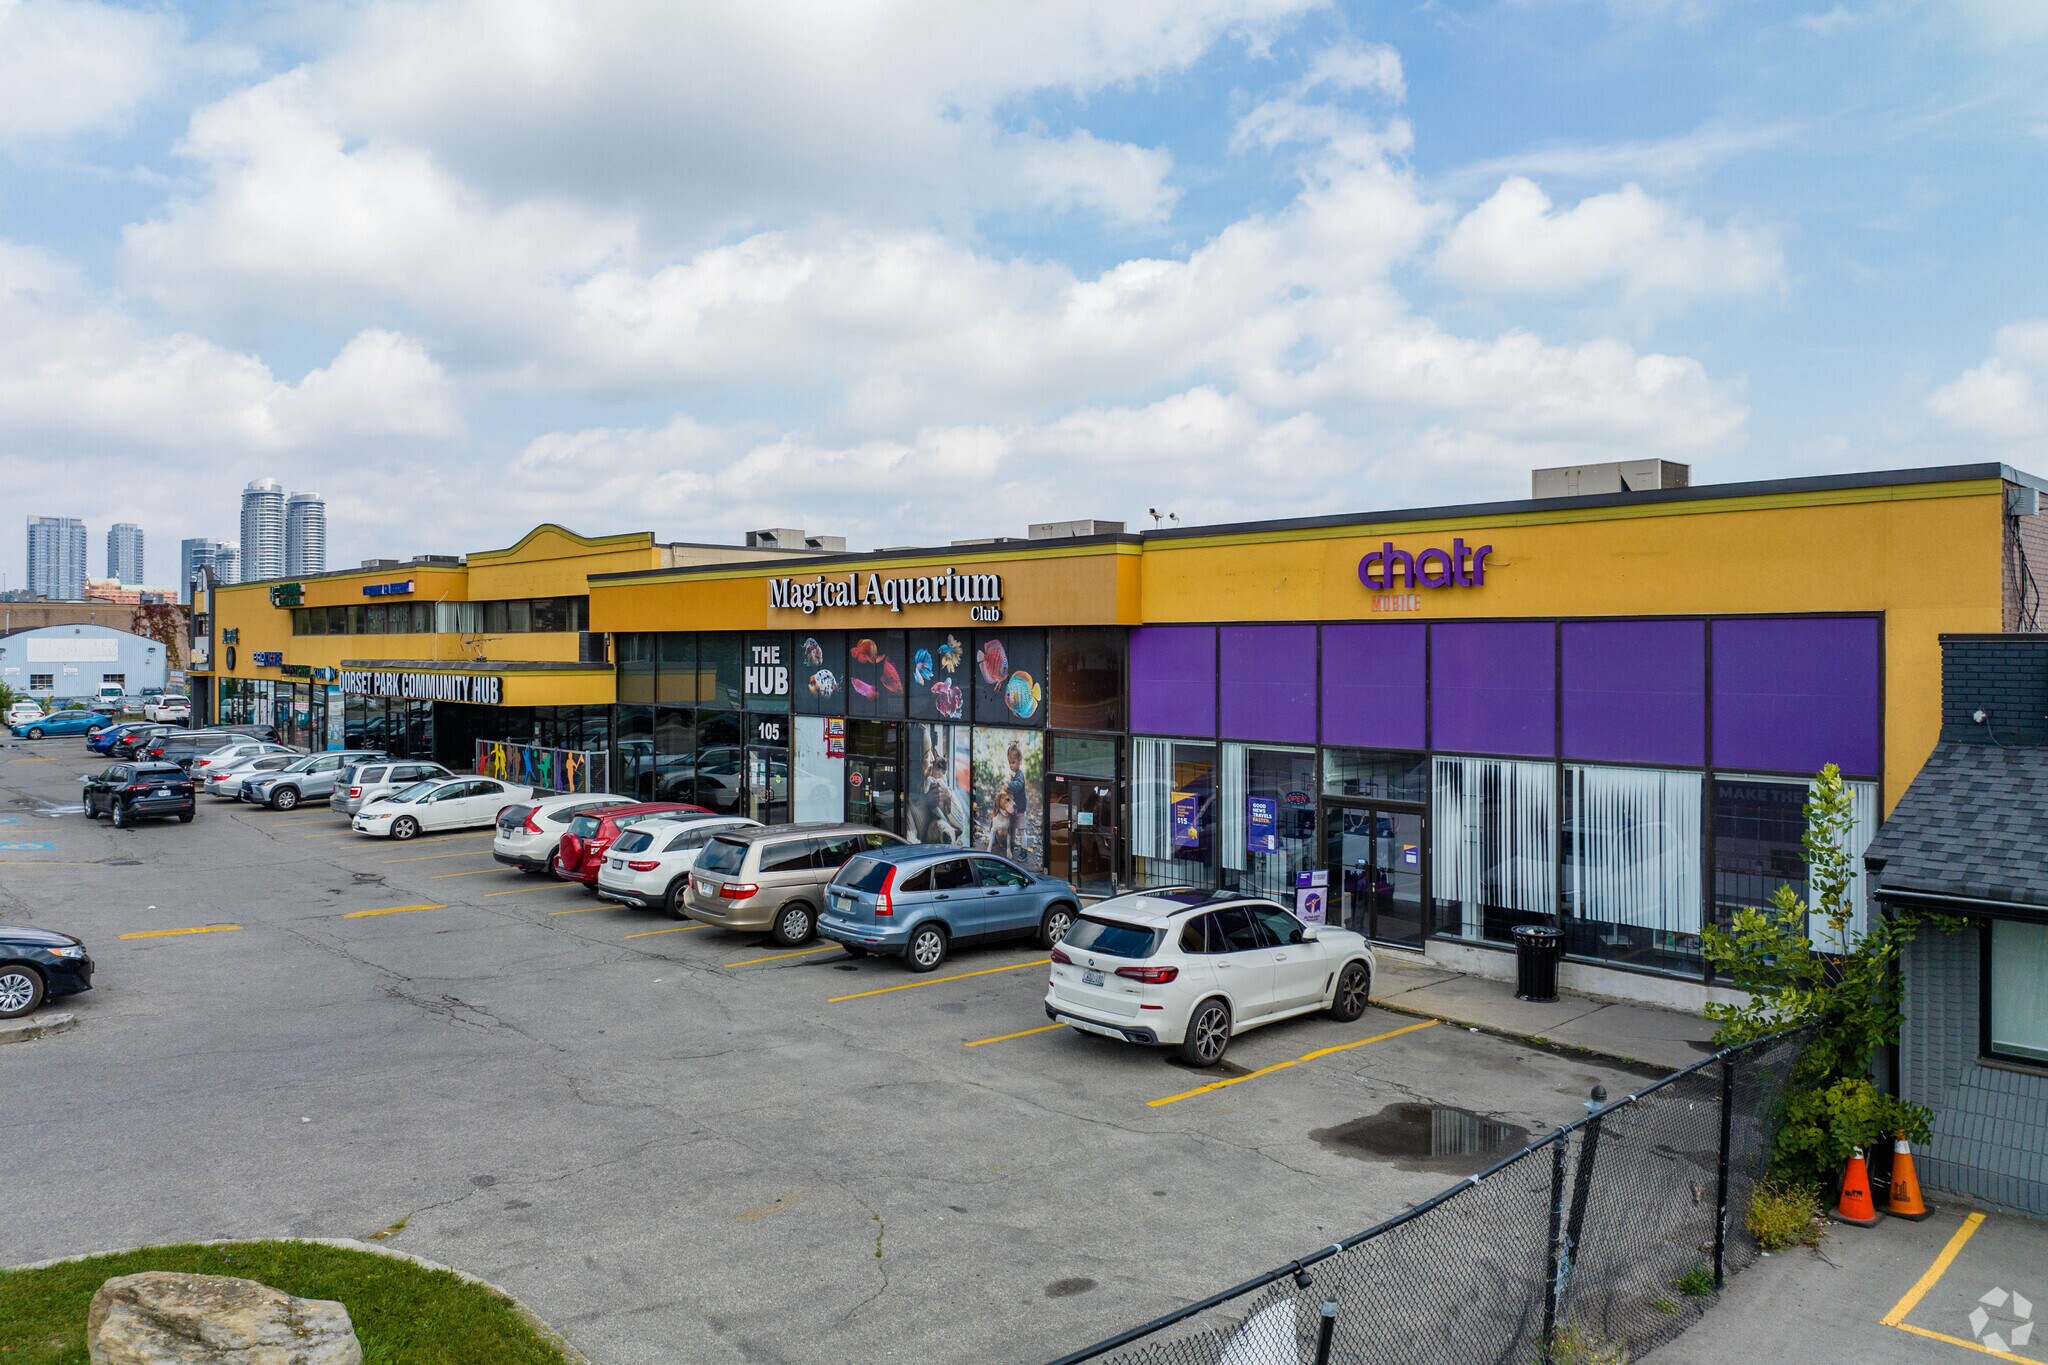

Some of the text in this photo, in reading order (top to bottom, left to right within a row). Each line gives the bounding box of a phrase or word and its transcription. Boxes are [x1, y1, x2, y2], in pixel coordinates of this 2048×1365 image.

[1357, 537, 1493, 590] chatr
[769, 567, 1001, 615] Magical Aquarium
[970, 605, 1000, 622] Club
[751, 645, 781, 665] THE
[338, 671, 372, 694] DORSET
[374, 672, 400, 696] PARK
[401, 673, 470, 701] COMMUNITY
[472, 677, 499, 704] HUB
[744, 666, 789, 696] HUB
[758, 722, 780, 741] 105
[1719, 786, 1804, 803] MAKE THE
[1177, 817, 1188, 825] $15
